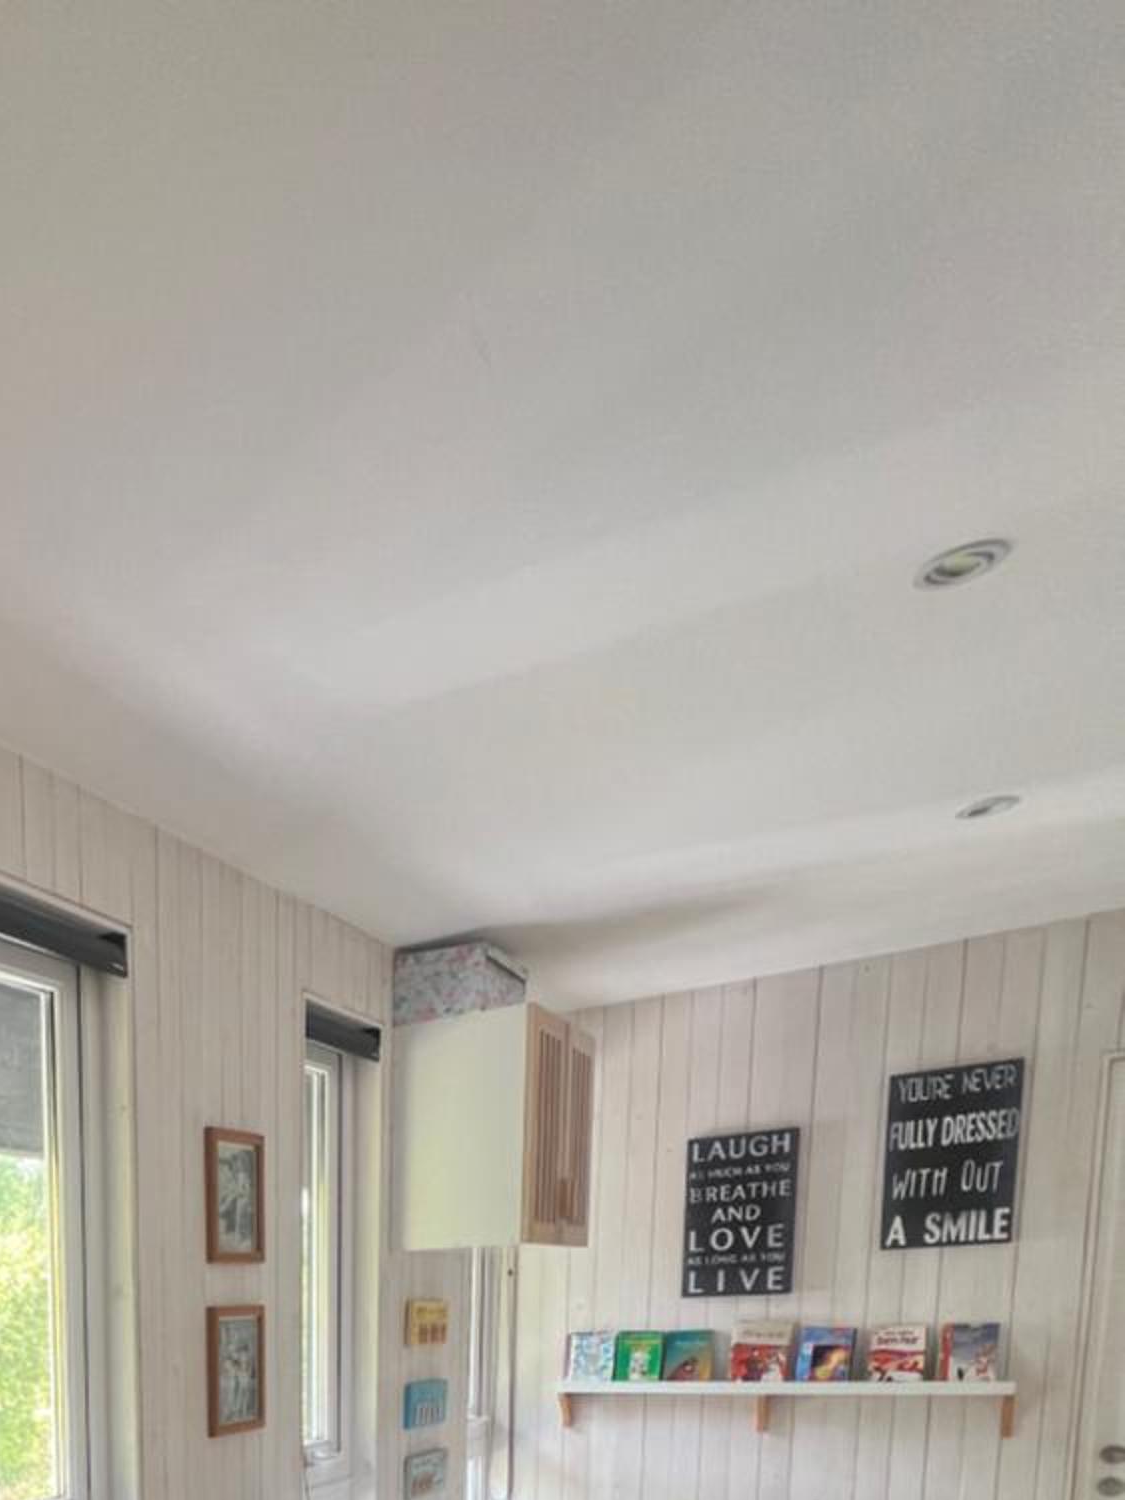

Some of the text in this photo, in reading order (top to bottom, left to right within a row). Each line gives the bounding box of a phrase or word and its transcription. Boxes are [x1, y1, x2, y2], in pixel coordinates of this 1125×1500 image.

[961, 1063, 1017, 1094] NEVER
[888, 1107, 1019, 1151] FULLY DRESSED
[692, 1132, 791, 1162] LAUGH
[690, 1179, 792, 1204] BREATHE
[892, 1158, 1004, 1200] WITH OUT
[711, 1203, 761, 1223] AND
[885, 1206, 1011, 1248] A SMILE
[688, 1223, 785, 1252] LOVE
[687, 1265, 785, 1294] LIVE
